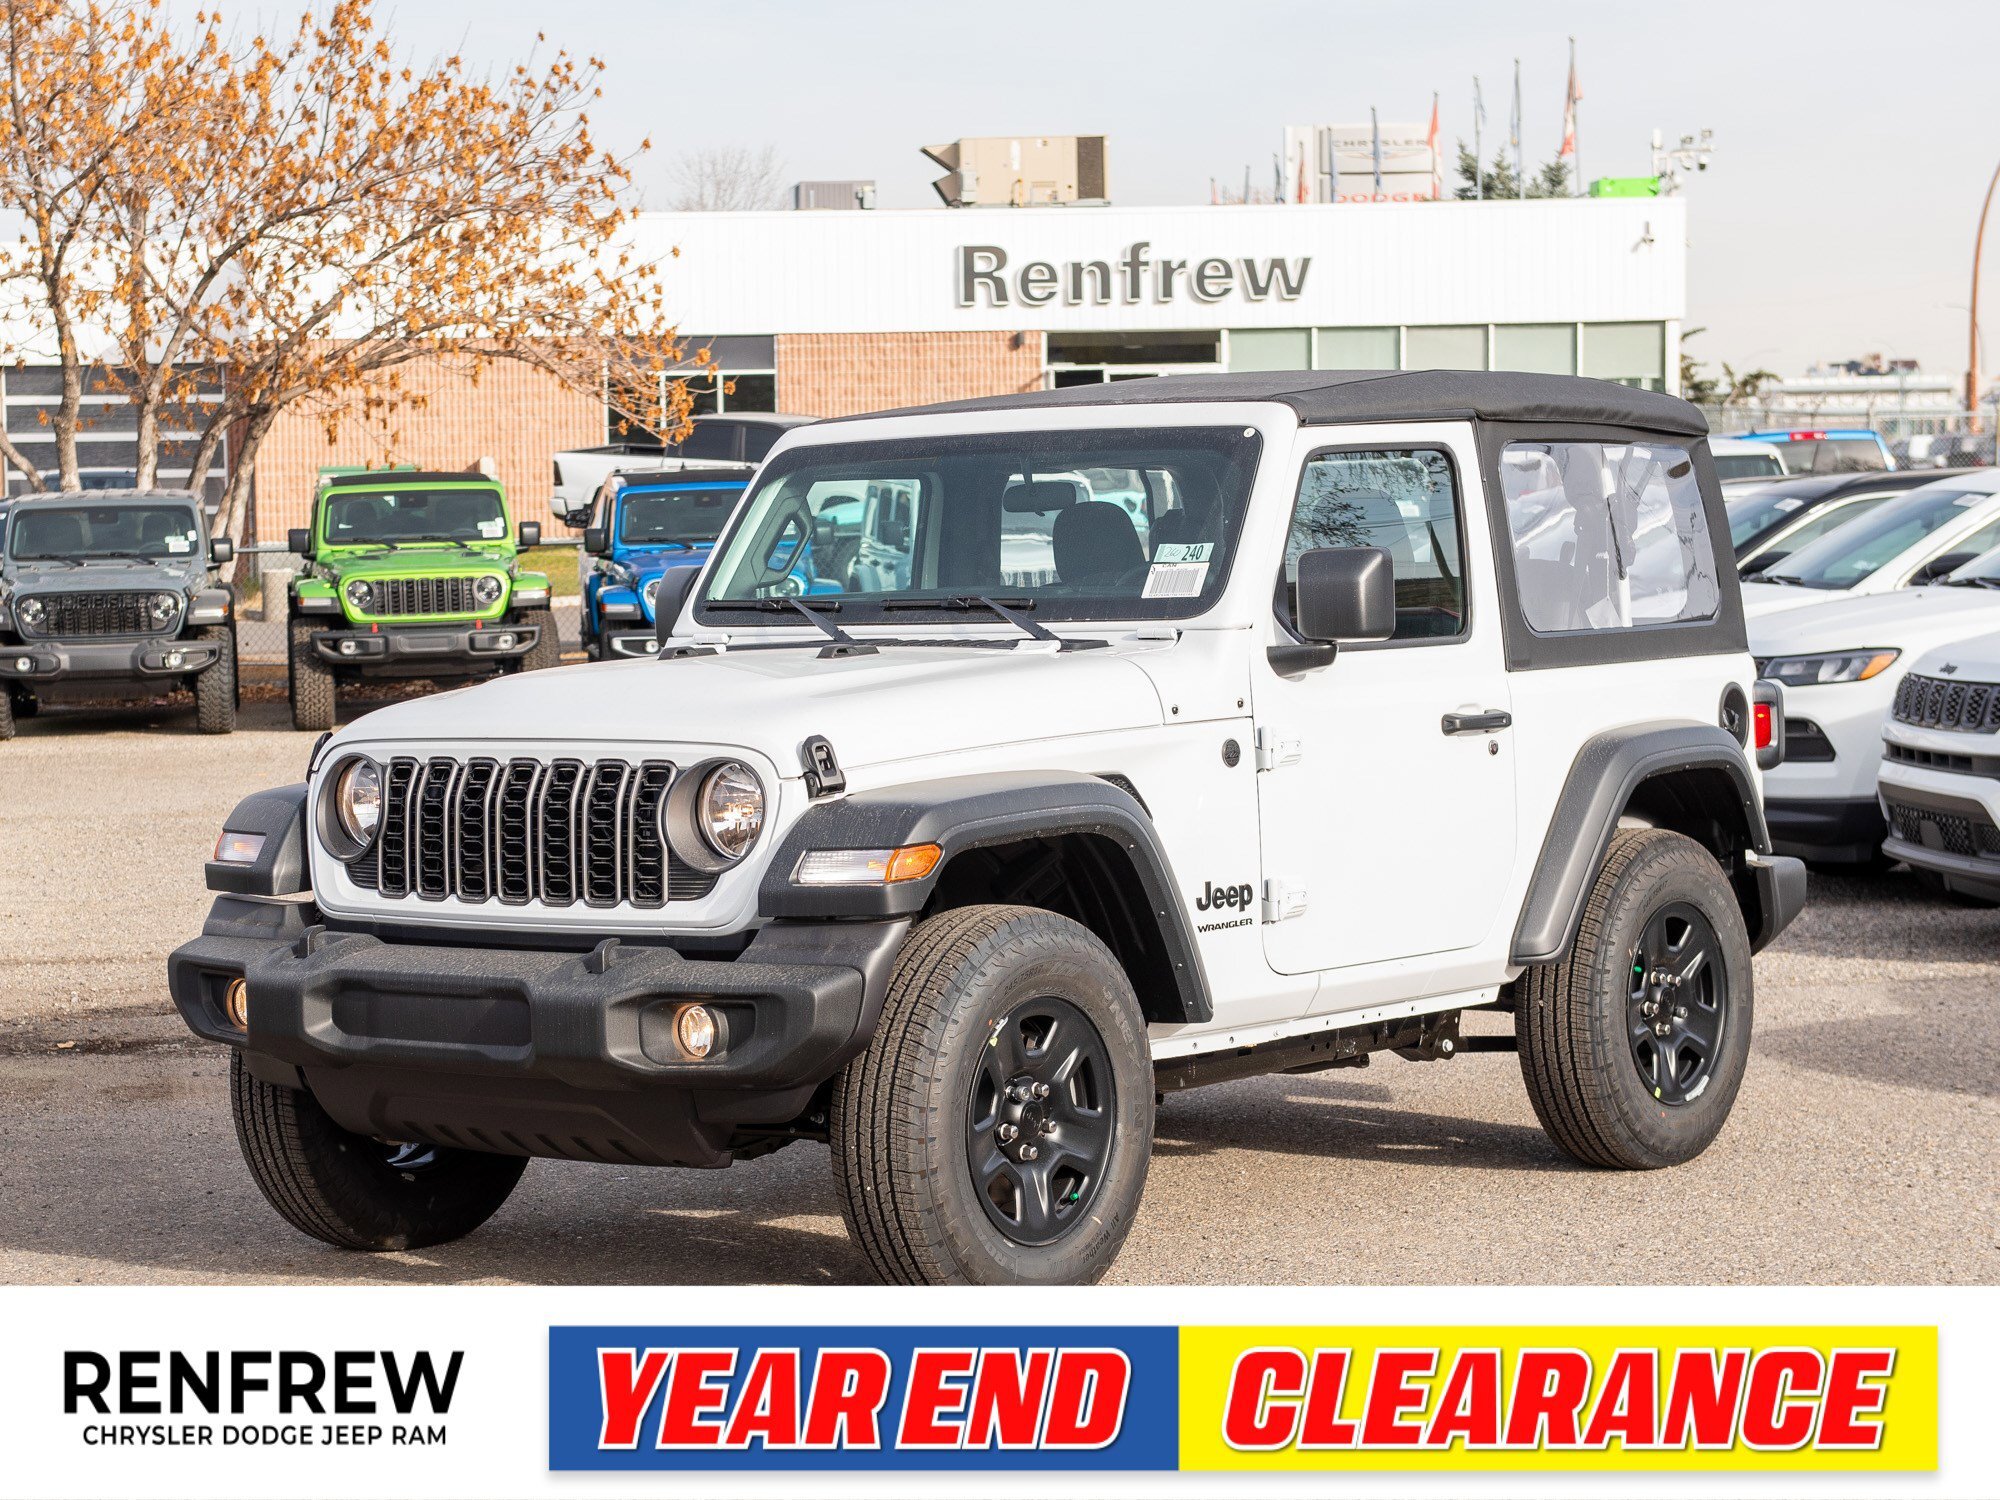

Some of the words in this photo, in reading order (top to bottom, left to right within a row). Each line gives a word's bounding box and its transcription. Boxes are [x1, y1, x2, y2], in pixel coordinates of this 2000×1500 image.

[956, 241, 1312, 306] Renfrew
[1181, 545, 1204, 561] 240
[1195, 881, 1253, 912] Jeep
[1197, 917, 1253, 933] WRANGLER
